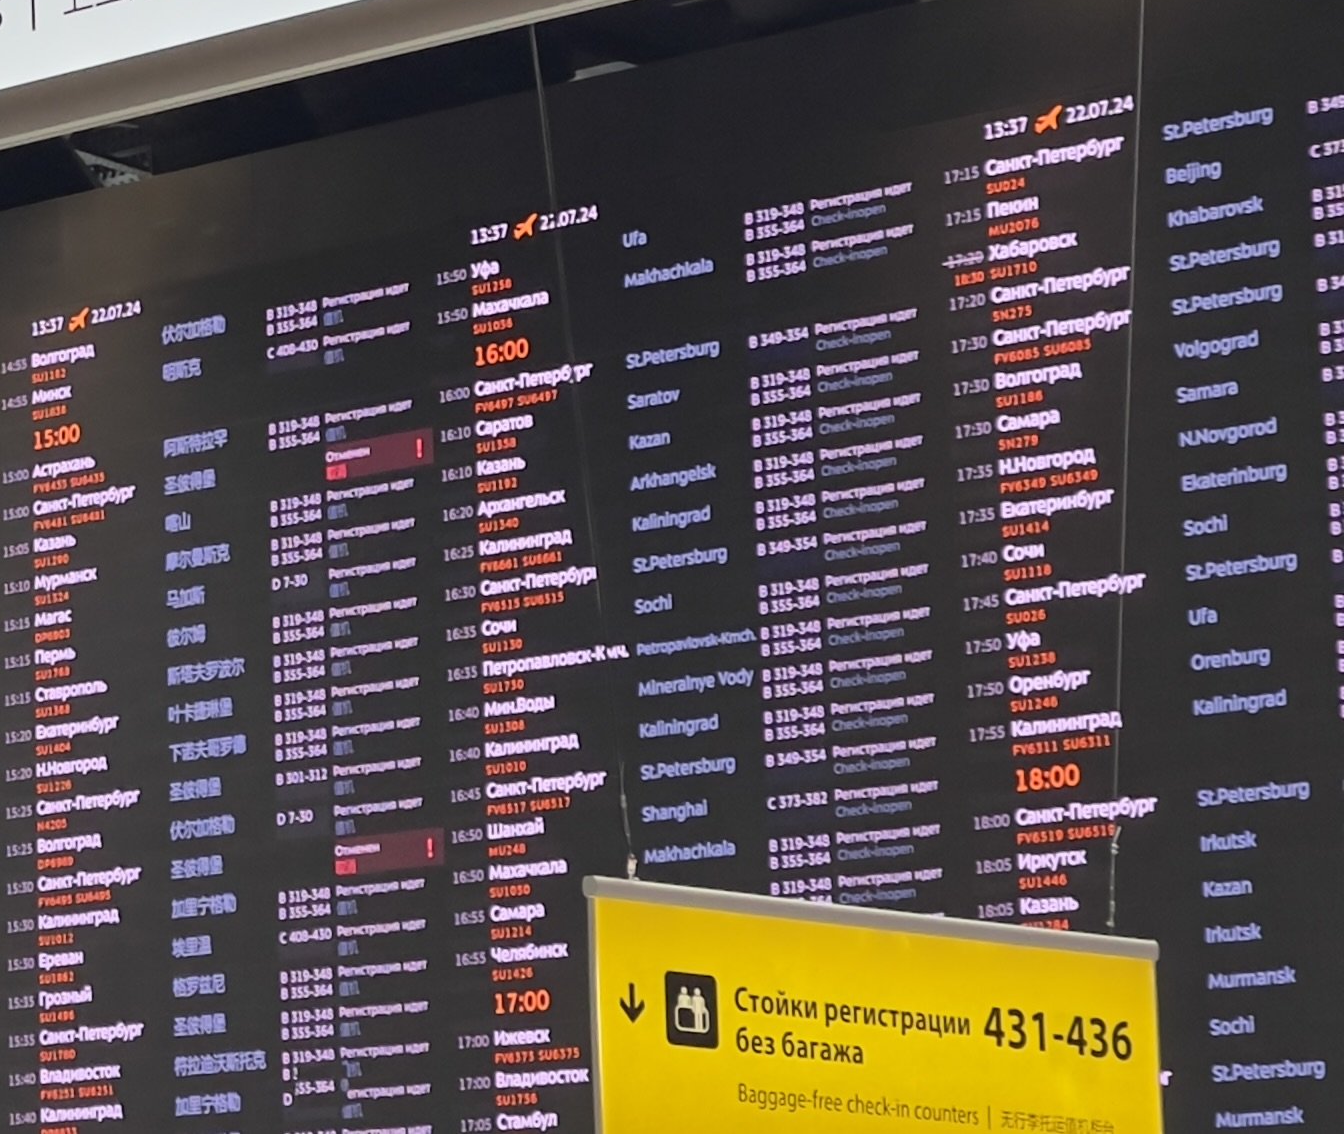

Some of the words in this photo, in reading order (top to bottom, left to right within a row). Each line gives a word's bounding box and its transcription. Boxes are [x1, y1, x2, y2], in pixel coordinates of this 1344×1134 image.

[985, 117, 1027, 139] 13:37
[1066, 96, 1134, 123] 22.07.24
[1163, 108, 1273, 140] St.Petersburg
[984, 137, 1124, 176] Санкт-Петербург
[1166, 162, 1221, 184] Beijing
[987, 197, 1038, 218] Пекин
[1168, 196, 1263, 227] Khabarovsk
[472, 224, 507, 244] 13:37
[623, 231, 647, 247] Ufa
[989, 233, 1077, 261] Хабаровск
[1170, 240, 1280, 271] St.Petersburg
[471, 260, 499, 280] Уфа
[625, 258, 713, 287] Makhachkala
[990, 266, 1130, 303] Санкт-Петербург
[473, 291, 549, 317] Махачкала
[32, 317, 63, 336] 13:37
[92, 301, 141, 323] 22.07.24
[31, 345, 95, 367] Волгоград
[476, 338, 528, 366] 16:00
[626, 341, 719, 369] St.Petersburg
[1174, 330, 1258, 359] Volgograd
[995, 363, 1082, 389] Волгоград
[32, 386, 71, 404] Минск
[628, 390, 679, 409] Saratov
[1177, 382, 1238, 403] Samara
[475, 415, 533, 437] Саратов
[996, 410, 1060, 432] Самара
[1180, 417, 1277, 447] N.Novgorod
[35, 424, 80, 449] 15:00
[629, 433, 670, 449] Kazan
[999, 448, 1096, 475] Н.Новгород
[630, 463, 716, 491] Arkhangelsk
[1182, 464, 1287, 491] Ekaterinburg
[478, 490, 565, 518] Архангельск
[1001, 489, 1114, 518] Екатеринбург
[1184, 514, 1227, 536] Sochi
[479, 530, 572, 555] Калининград
[1002, 544, 1044, 562] Сочи
[34, 568, 97, 591] Мурманск
[1186, 554, 1297, 581] St.Petersburg
[635, 594, 672, 614] Sochi
[481, 620, 516, 636] Сочи
[1006, 630, 1040, 651] Уфа
[1191, 649, 1270, 670] Orenburg
[639, 675, 715, 696] Mineralnye
[718, 668, 753, 686] Vody
[1009, 670, 1090, 695] Оренбург
[484, 696, 554, 717] Мин.Воды
[1194, 689, 1286, 715] Kaliningrad
[640, 714, 718, 738] Kaliningrad
[1011, 712, 1122, 737] Калининград
[1017, 764, 1079, 791] 18:00
[1198, 782, 1309, 806] St.Petersburg
[642, 799, 707, 822] Shanghai
[1015, 797, 1157, 825] Санкт-Петербург
[487, 817, 544, 839] Шанхай
[1201, 831, 1256, 851] Irkutsk
[1018, 850, 1086, 873] Иркутск
[1203, 881, 1252, 897] Kazan
[490, 904, 544, 922] Самара
[1020, 897, 1079, 914] Казань
[491, 943, 568, 962] Челябинск
[1209, 966, 1296, 989] Murmansk
[496, 990, 549, 1014] 17:00
[735, 987, 817, 1018] Стойки
[825, 1003, 969, 1037] регистрации
[984, 1007, 1131, 1060] 431-436
[494, 1029, 550, 1045] Ижевск
[736, 1027, 775, 1054] без
[782, 1032, 864, 1063] багажа
[495, 1069, 589, 1088] Владивосток
[738, 1083, 842, 1112] Baggage-free
[847, 1094, 909, 1117] check-in
[914, 1106, 979, 1125] counters
